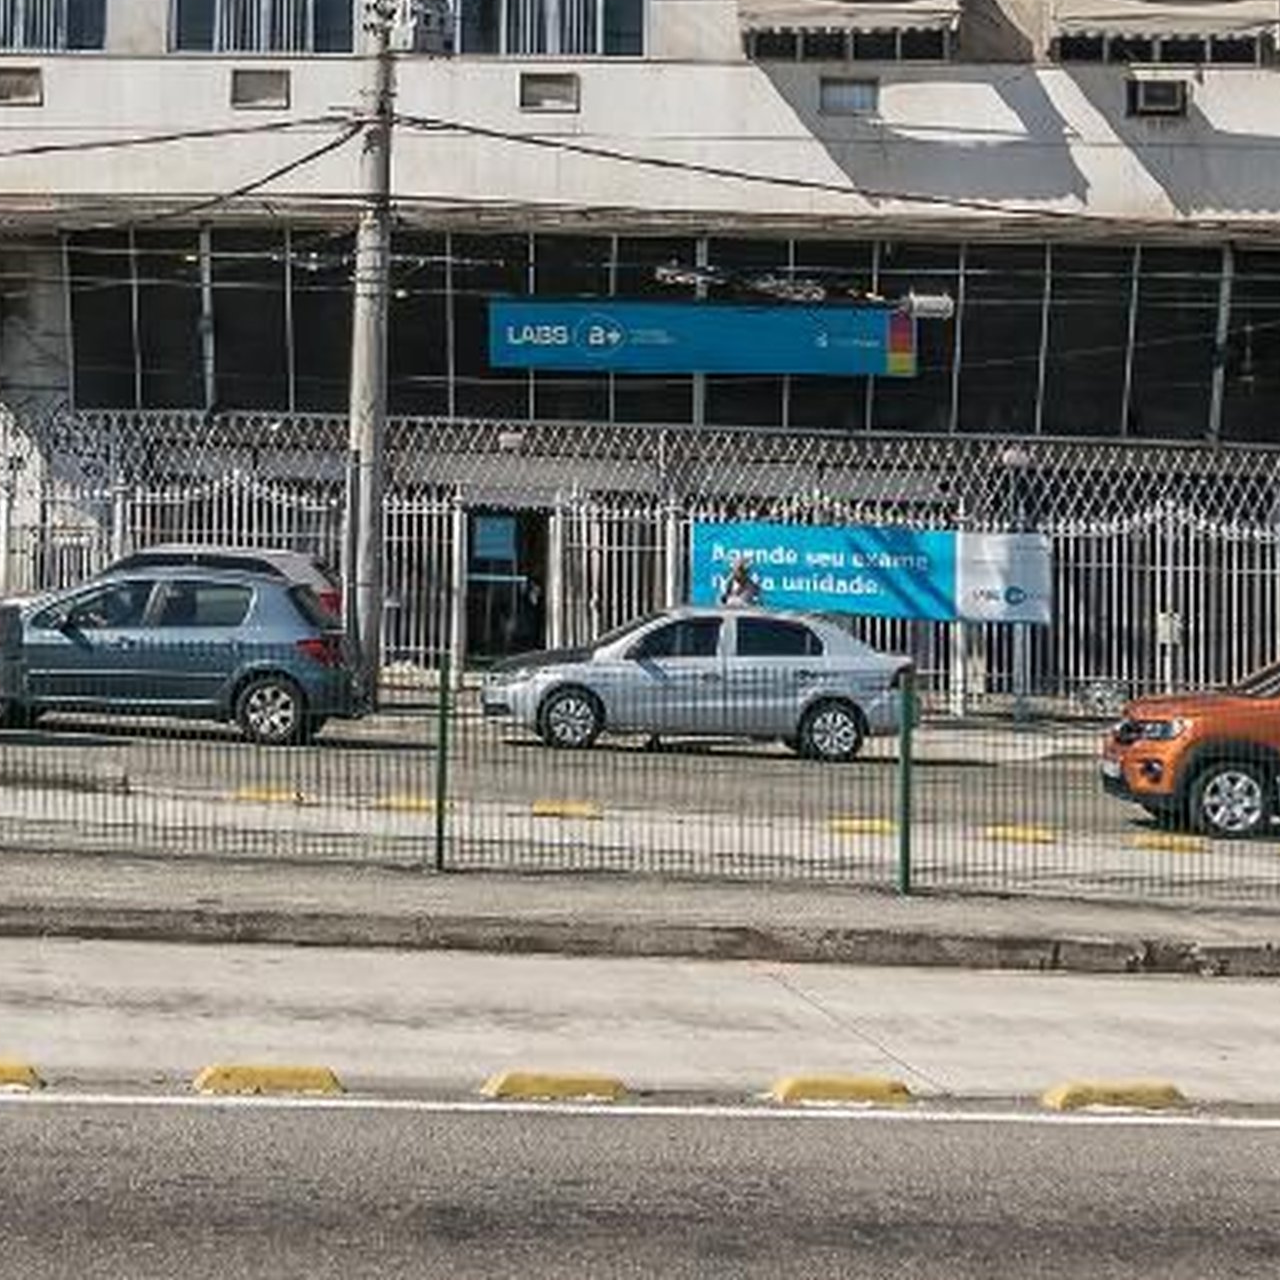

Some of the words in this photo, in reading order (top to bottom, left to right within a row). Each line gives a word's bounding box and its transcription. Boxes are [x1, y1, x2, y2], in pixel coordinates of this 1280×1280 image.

[506, 325, 568, 344] LABS
[710, 543, 798, 568] Agende
[805, 551, 845, 568] seu
[852, 551, 930, 571] exame
